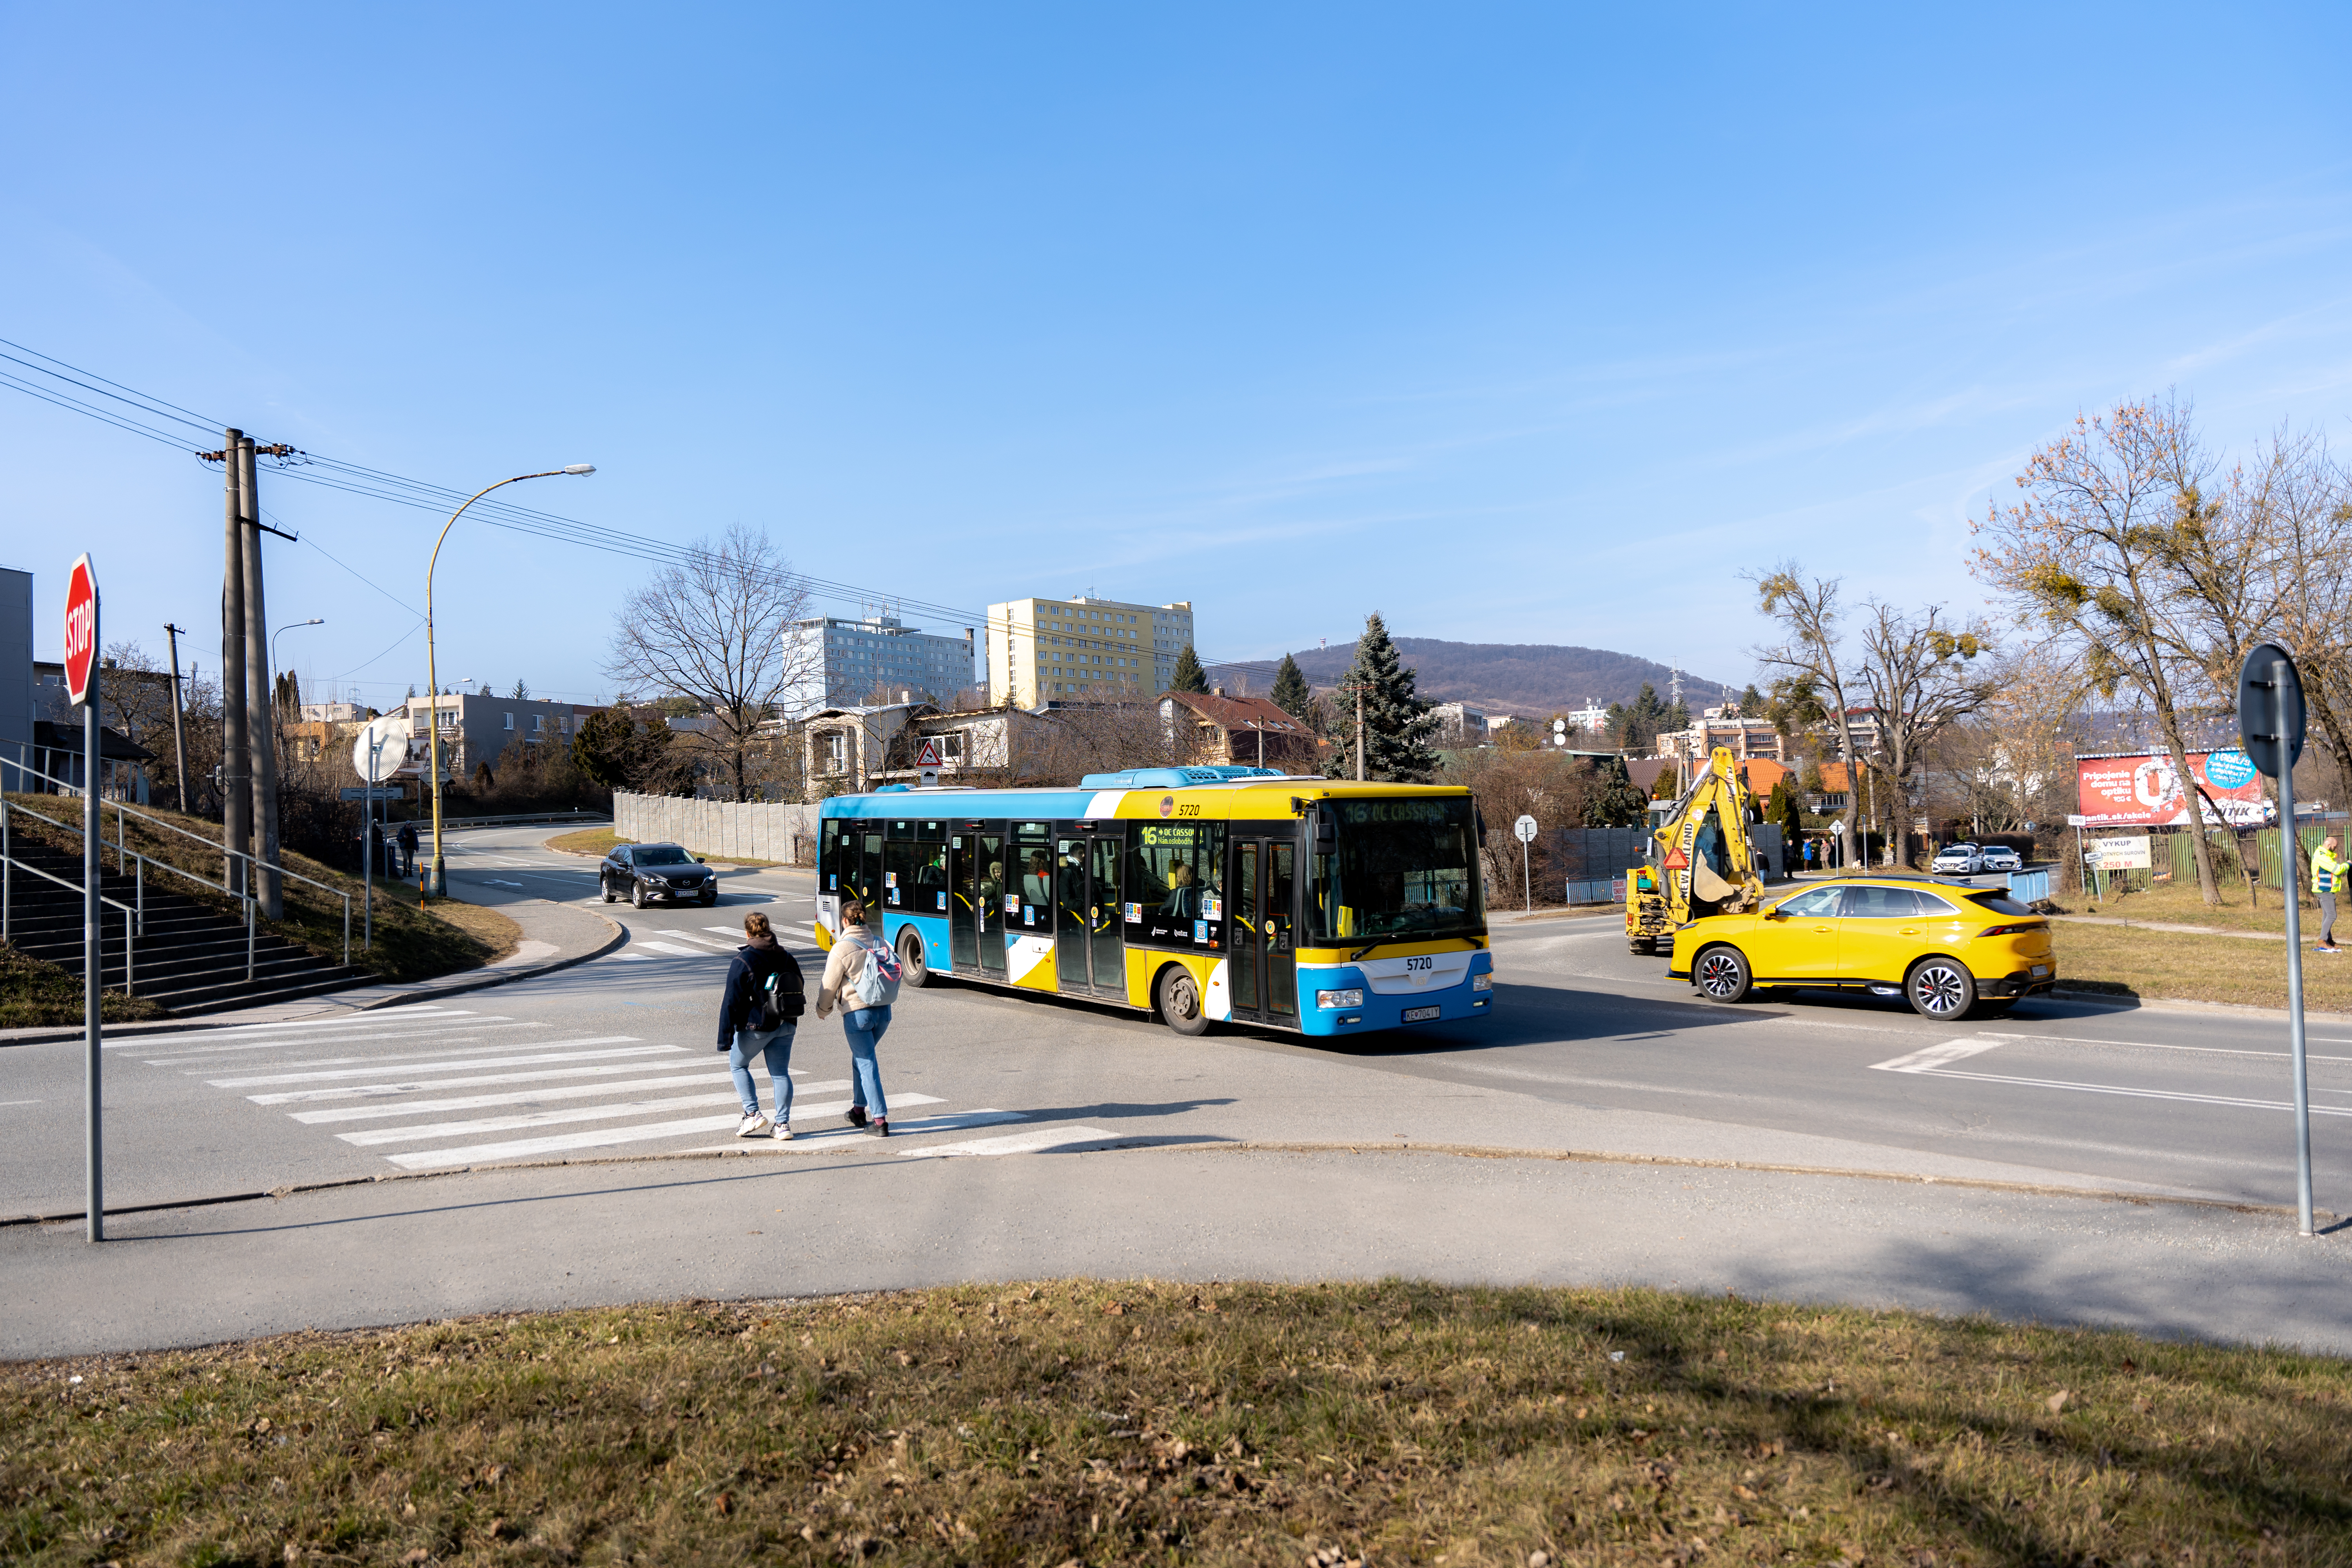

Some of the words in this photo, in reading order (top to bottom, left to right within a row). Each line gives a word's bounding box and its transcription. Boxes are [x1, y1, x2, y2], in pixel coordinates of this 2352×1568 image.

[67, 599, 91, 660] STOP
[2083, 770, 2131, 781] Pripojenie
[2101, 787, 2131, 797] optiku
[1179, 805, 1200, 816] 5720
[1345, 803, 1367, 823] 16
[2085, 811, 2151, 822] antik.sk/akcie
[1142, 827, 1156, 844] 16
[1680, 874, 1689, 898] NEW
[1407, 957, 1432, 971] 5720
[1406, 1011, 1415, 1020] KE
